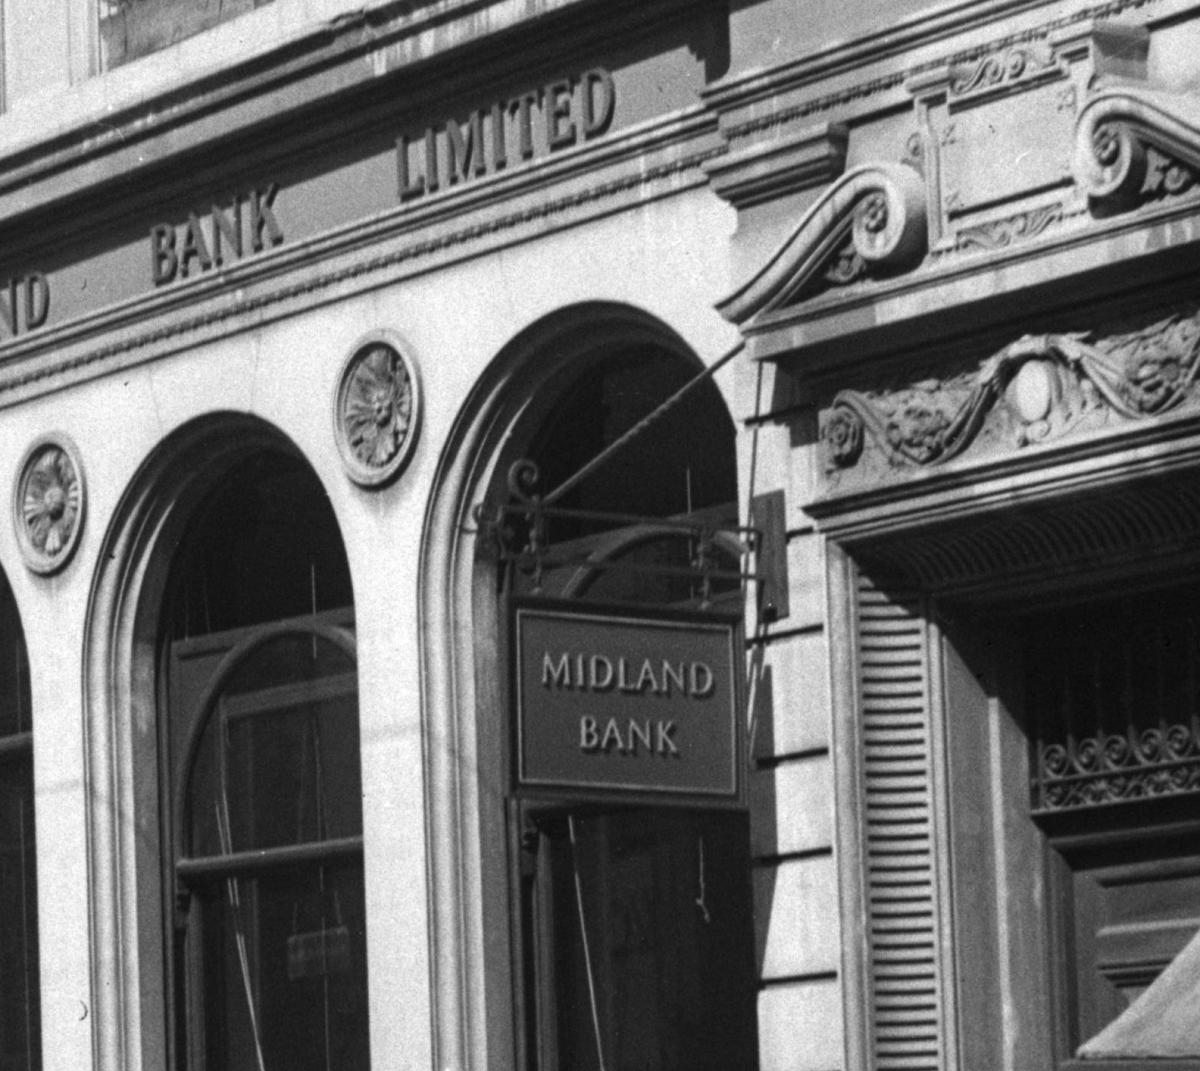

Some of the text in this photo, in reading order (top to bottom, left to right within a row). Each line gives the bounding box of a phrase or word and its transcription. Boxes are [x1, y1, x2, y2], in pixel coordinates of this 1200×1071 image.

[149, 181, 284, 287] BANK
[396, 66, 616, 197] LIMITED
[541, 650, 715, 697] MIDLAND
[580, 714, 679, 755] BANK
